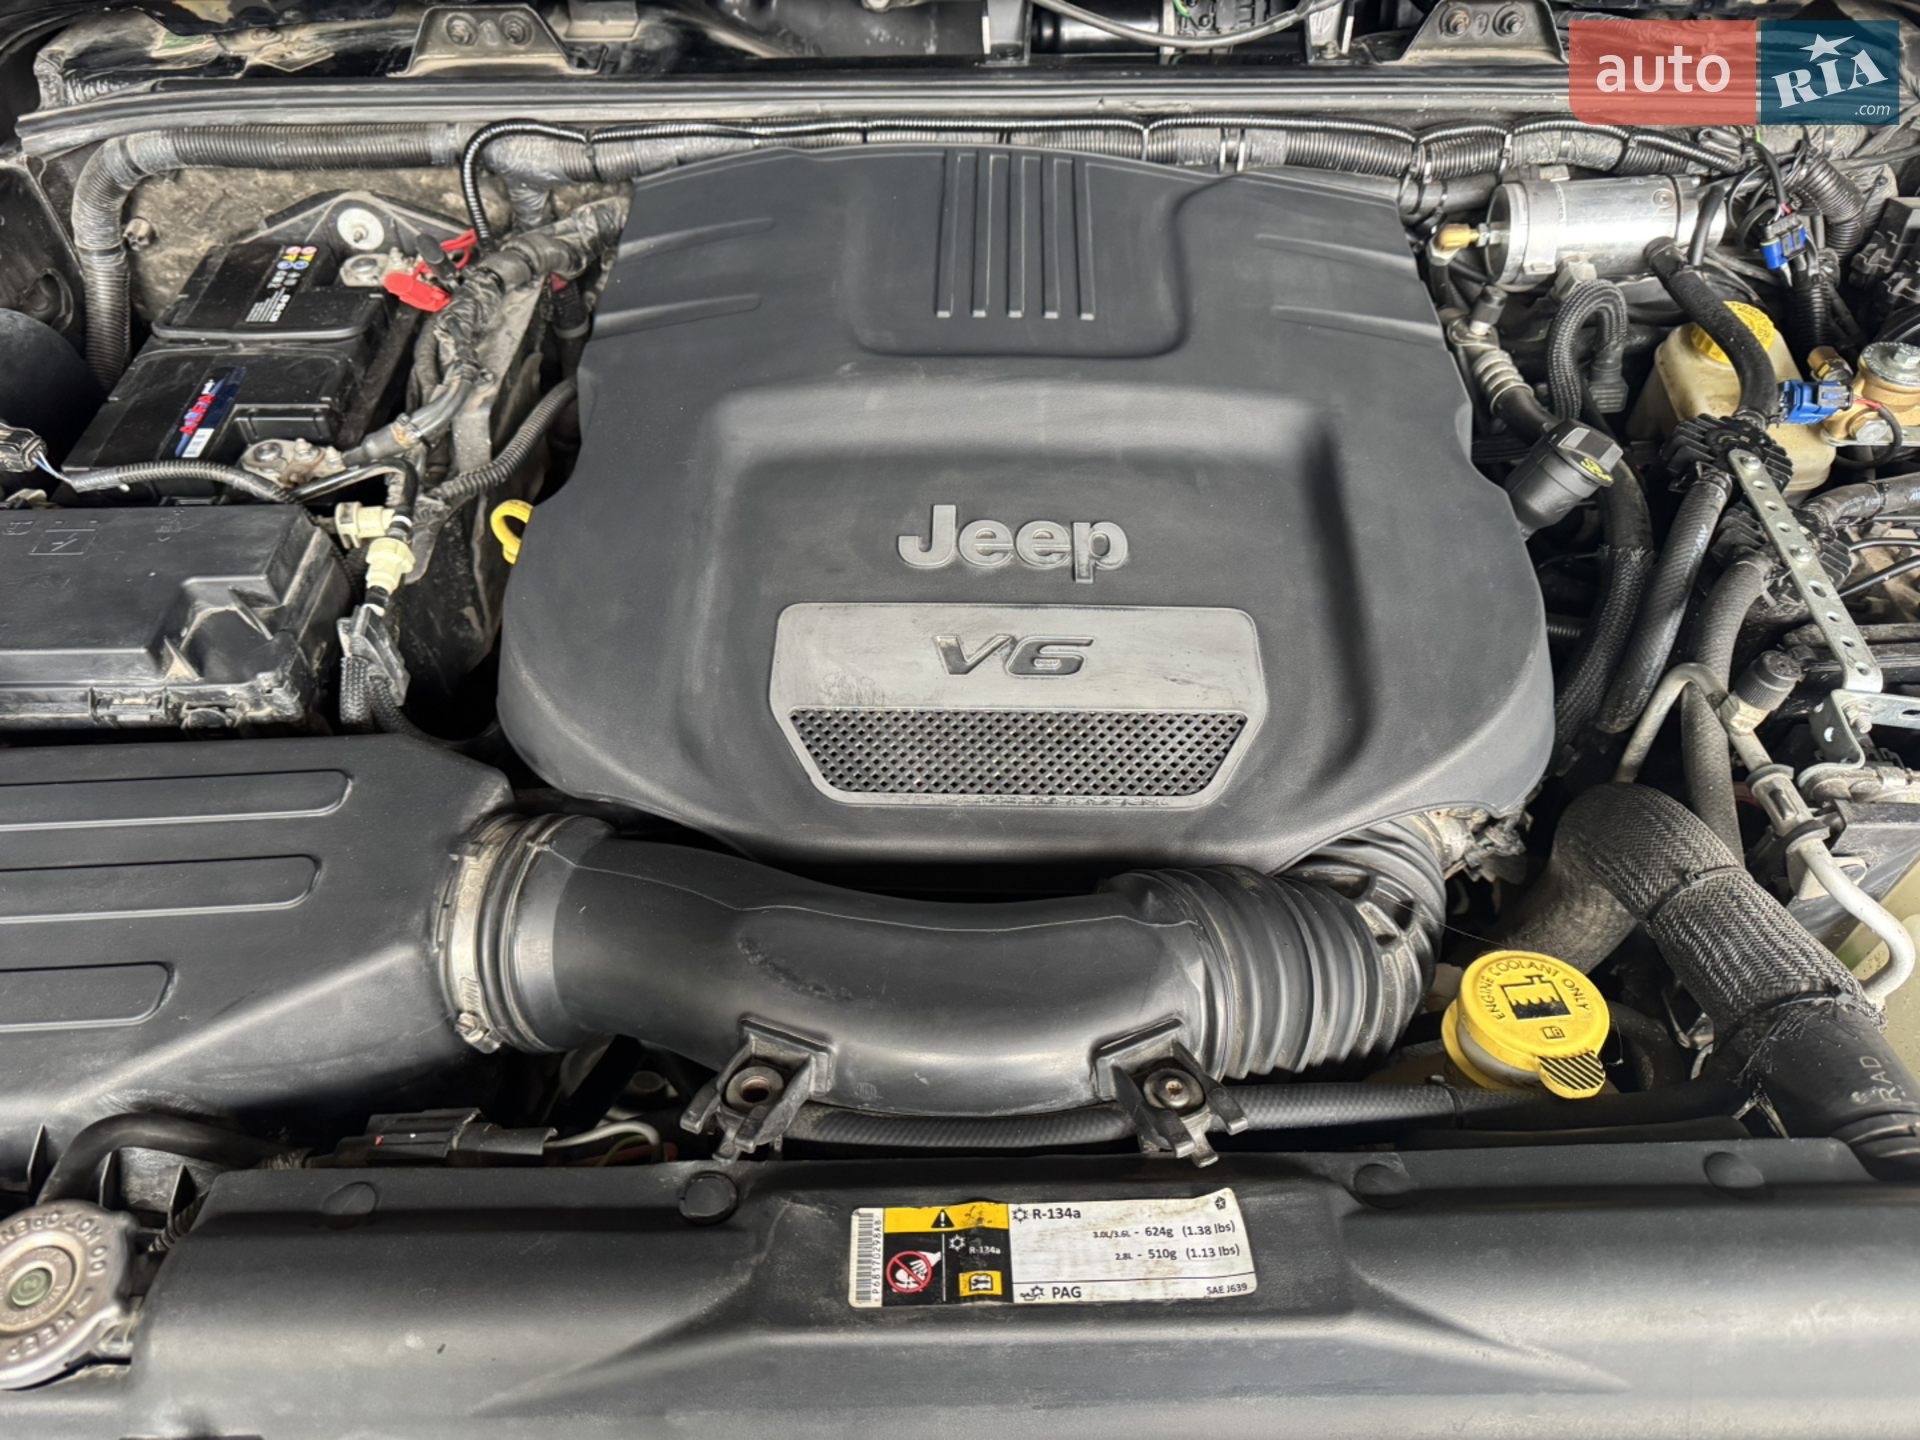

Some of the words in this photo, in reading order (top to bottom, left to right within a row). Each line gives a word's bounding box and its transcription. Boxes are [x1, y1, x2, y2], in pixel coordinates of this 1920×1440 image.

[897, 504, 1129, 584] Jeep
[934, 635, 1096, 677] V6
[1488, 958, 1561, 978] COOLANT
[1479, 975, 1506, 1021] ENGINE
[1563, 978, 1591, 1013] ONLY
[1859, 1055, 1902, 1102] RAD
[1032, 1208, 1082, 1220] R-134a
[1144, 1226, 1174, 1238] 624g
[1182, 1224, 1212, 1238] (1.38
[1214, 1220, 1236, 1235] lbs)
[1147, 1248, 1177, 1261] 510g
[1185, 1247, 1216, 1261] (1.13
[1219, 1243, 1241, 1258] lbs)
[1052, 1286, 1082, 1299] PAG
[1206, 1285, 1225, 1296] SAE
